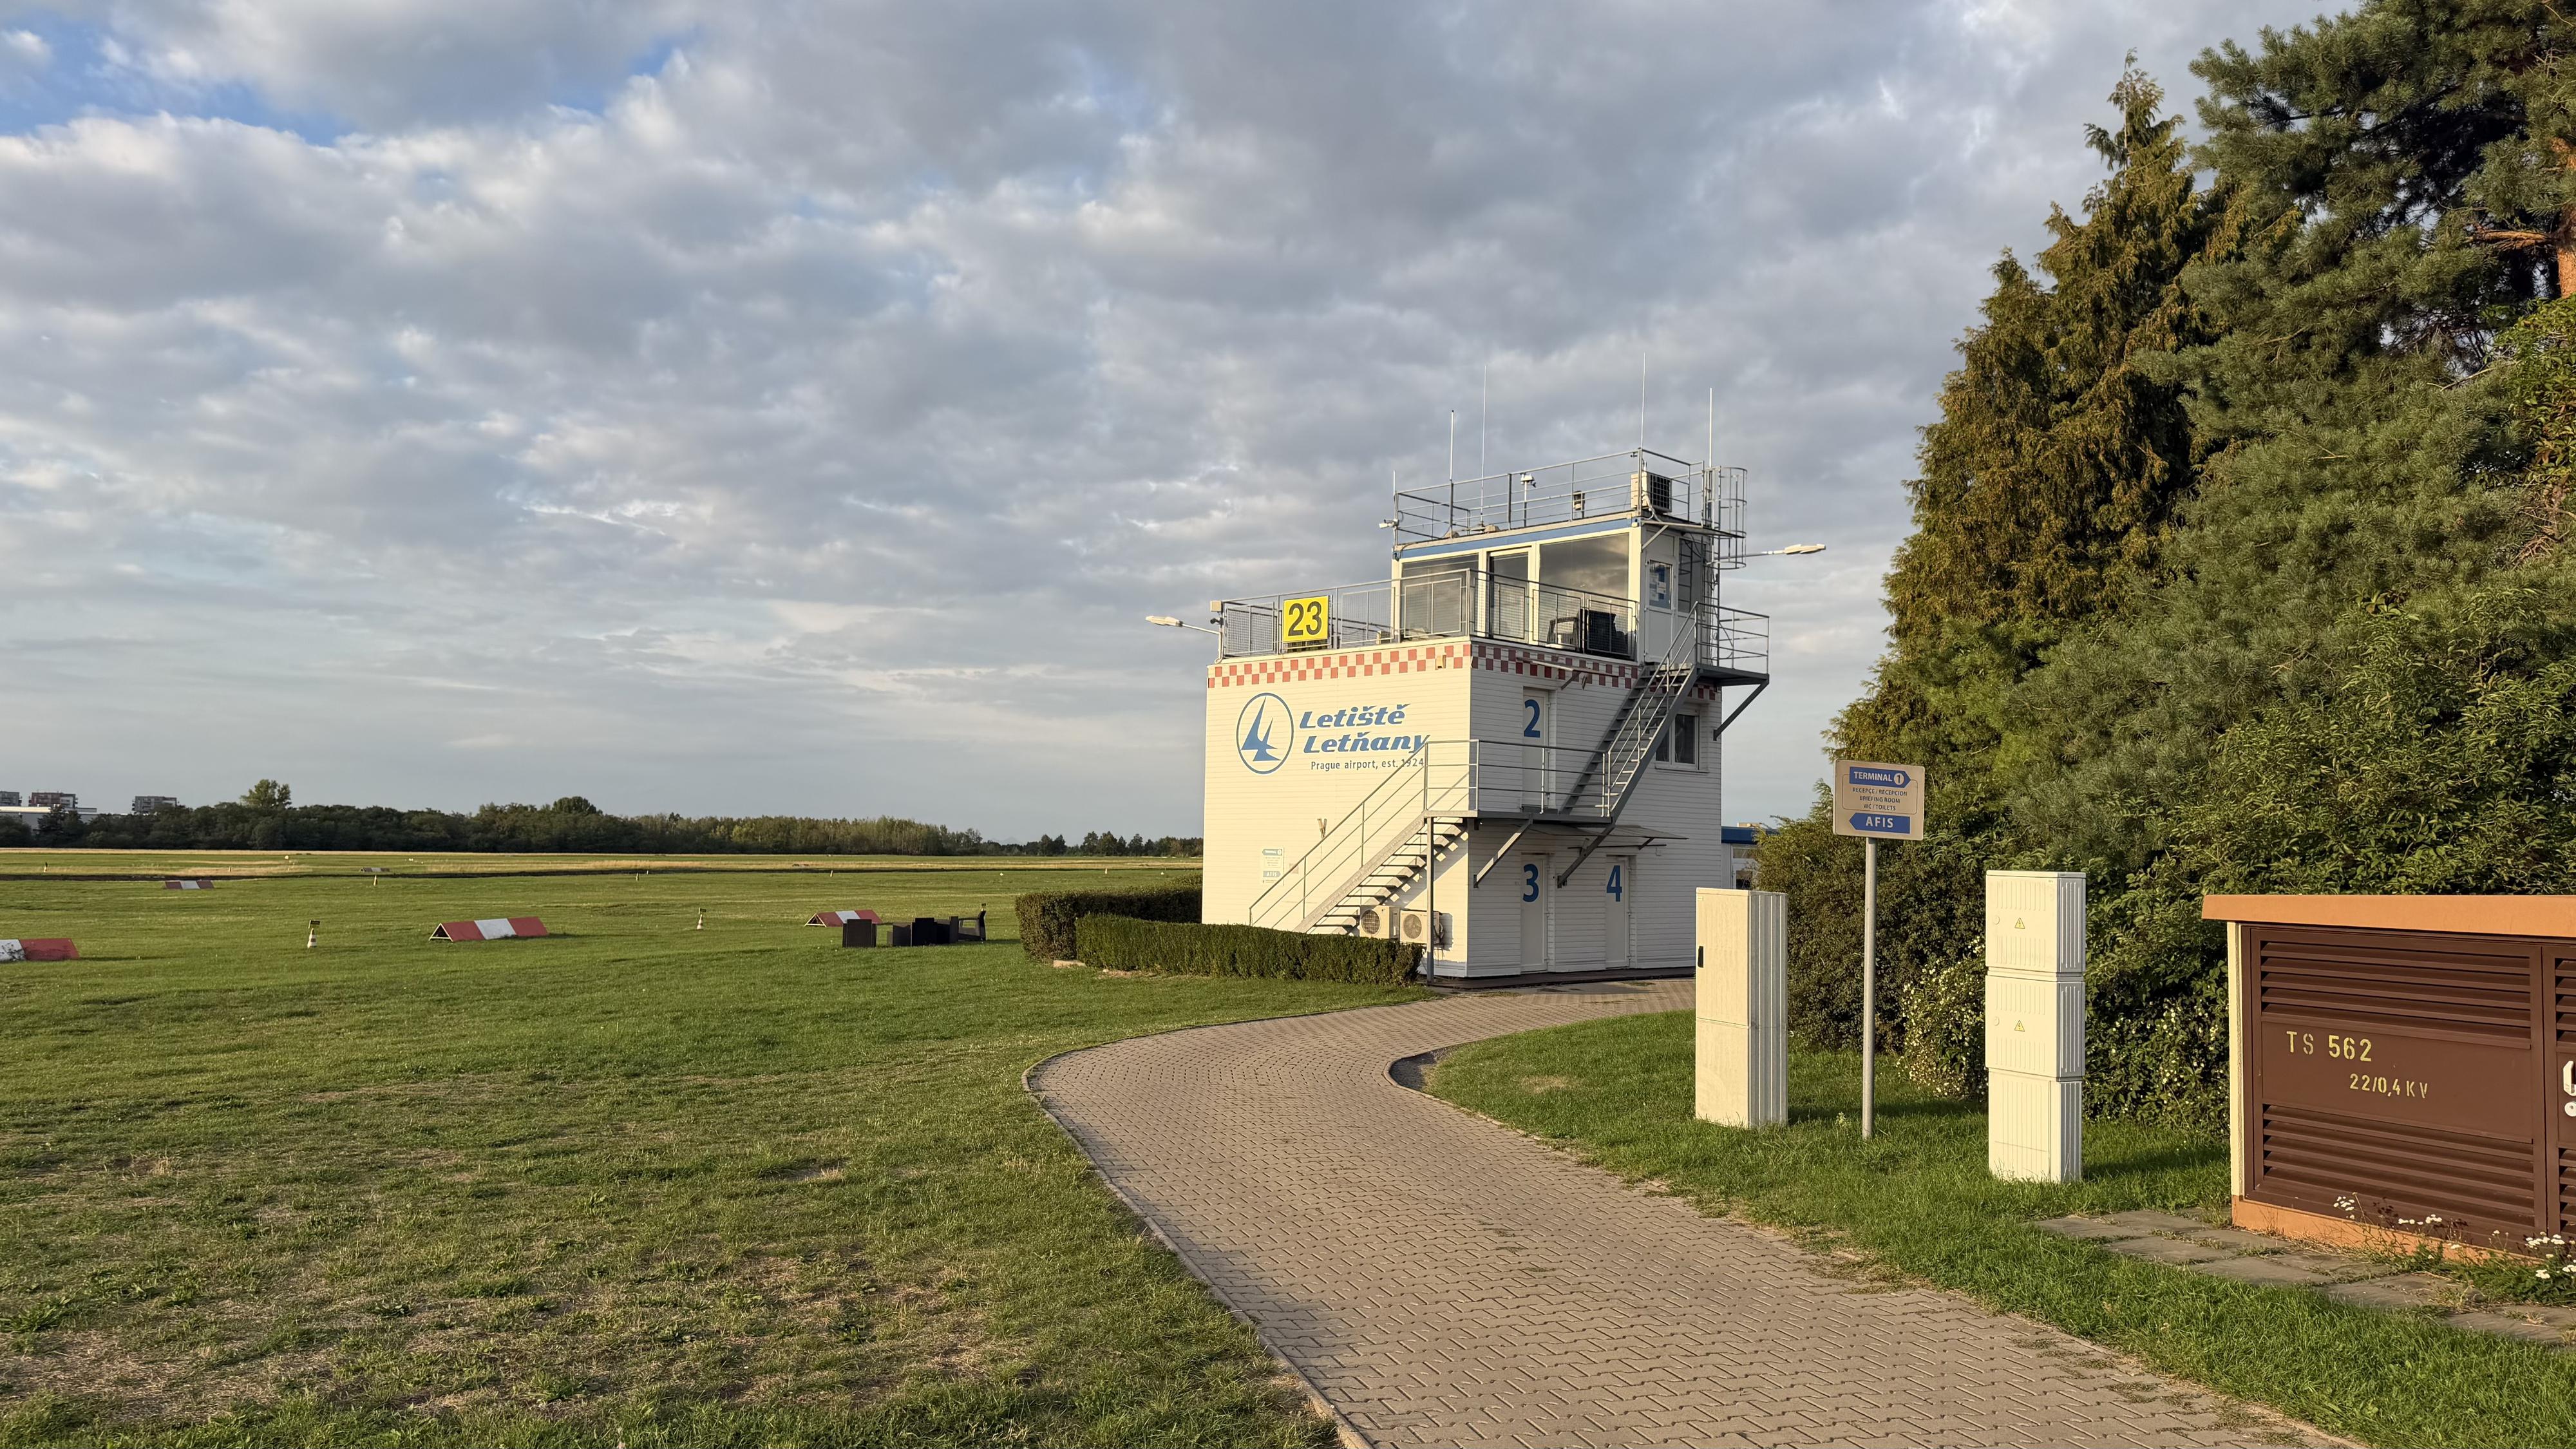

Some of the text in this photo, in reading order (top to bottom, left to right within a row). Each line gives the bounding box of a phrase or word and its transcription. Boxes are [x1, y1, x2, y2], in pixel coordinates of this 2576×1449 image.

[1288, 601, 1322, 637] 23
[1299, 703, 1411, 729] Letiště
[1524, 699, 1540, 738] 2
[1303, 732, 1430, 753] Letňany
[1311, 761, 1340, 772] Prague
[1345, 760, 1378, 770] airport,
[1381, 759, 1398, 768] est.
[1853, 772, 1901, 784] TERMINAL 1
[1866, 816, 1894, 828] AFIS
[1523, 864, 1539, 902] 3
[1606, 865, 1622, 902] 4
[2286, 1030, 2372, 1062] TS 562
[2350, 1073, 2401, 1097] 22/0,4
